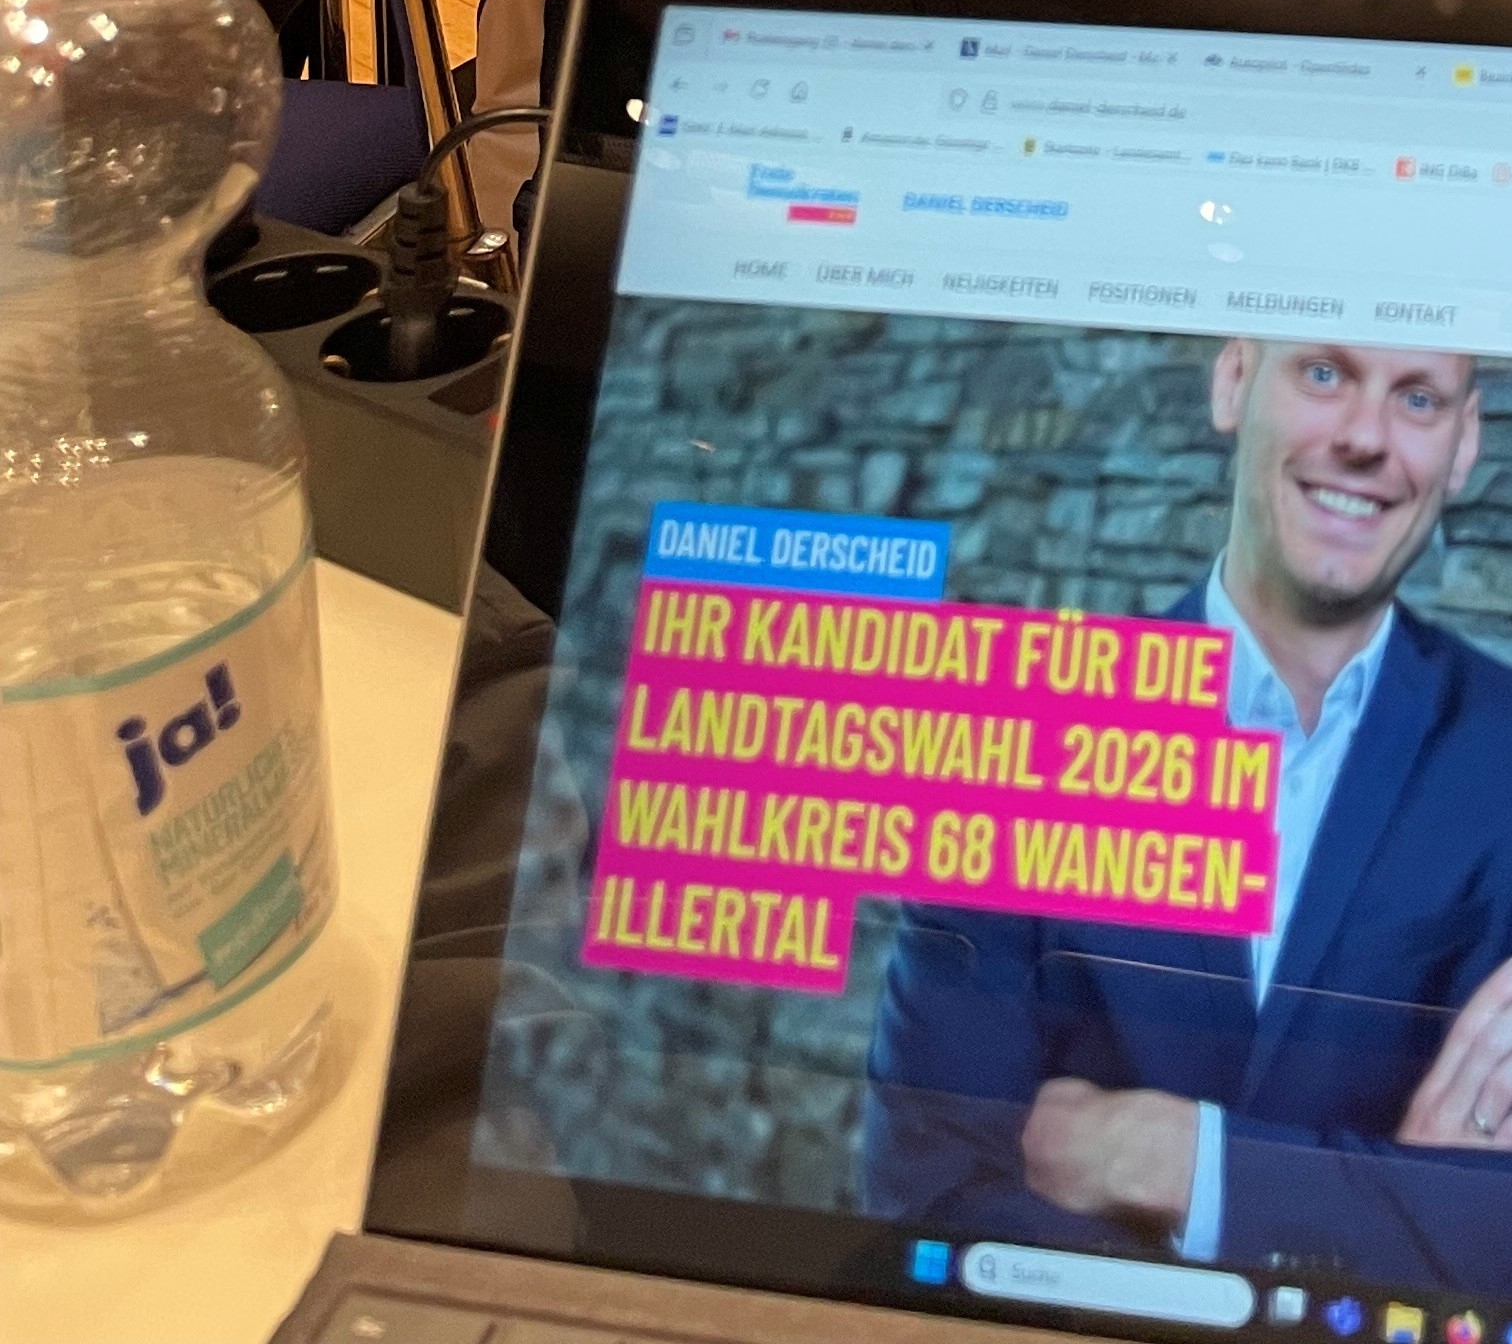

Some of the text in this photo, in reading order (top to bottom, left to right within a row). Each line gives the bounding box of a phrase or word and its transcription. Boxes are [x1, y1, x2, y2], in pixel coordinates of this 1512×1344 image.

[734, 259, 789, 280] HOME
[1089, 280, 1197, 308] POSITIONEN
[1374, 300, 1458, 328] KONTAKT
[657, 519, 938, 580] DANIEL DERSCHEID
[643, 590, 1223, 707] IHR KANDIDAT FÜR DIE
[115, 659, 243, 816] ja!
[627, 684, 1270, 812] LANDTAGSWAHL 2026 IM
[616, 779, 1267, 911] WAHLKREIS 68 WANGEN-
[595, 874, 838, 970] ILLERTAL
